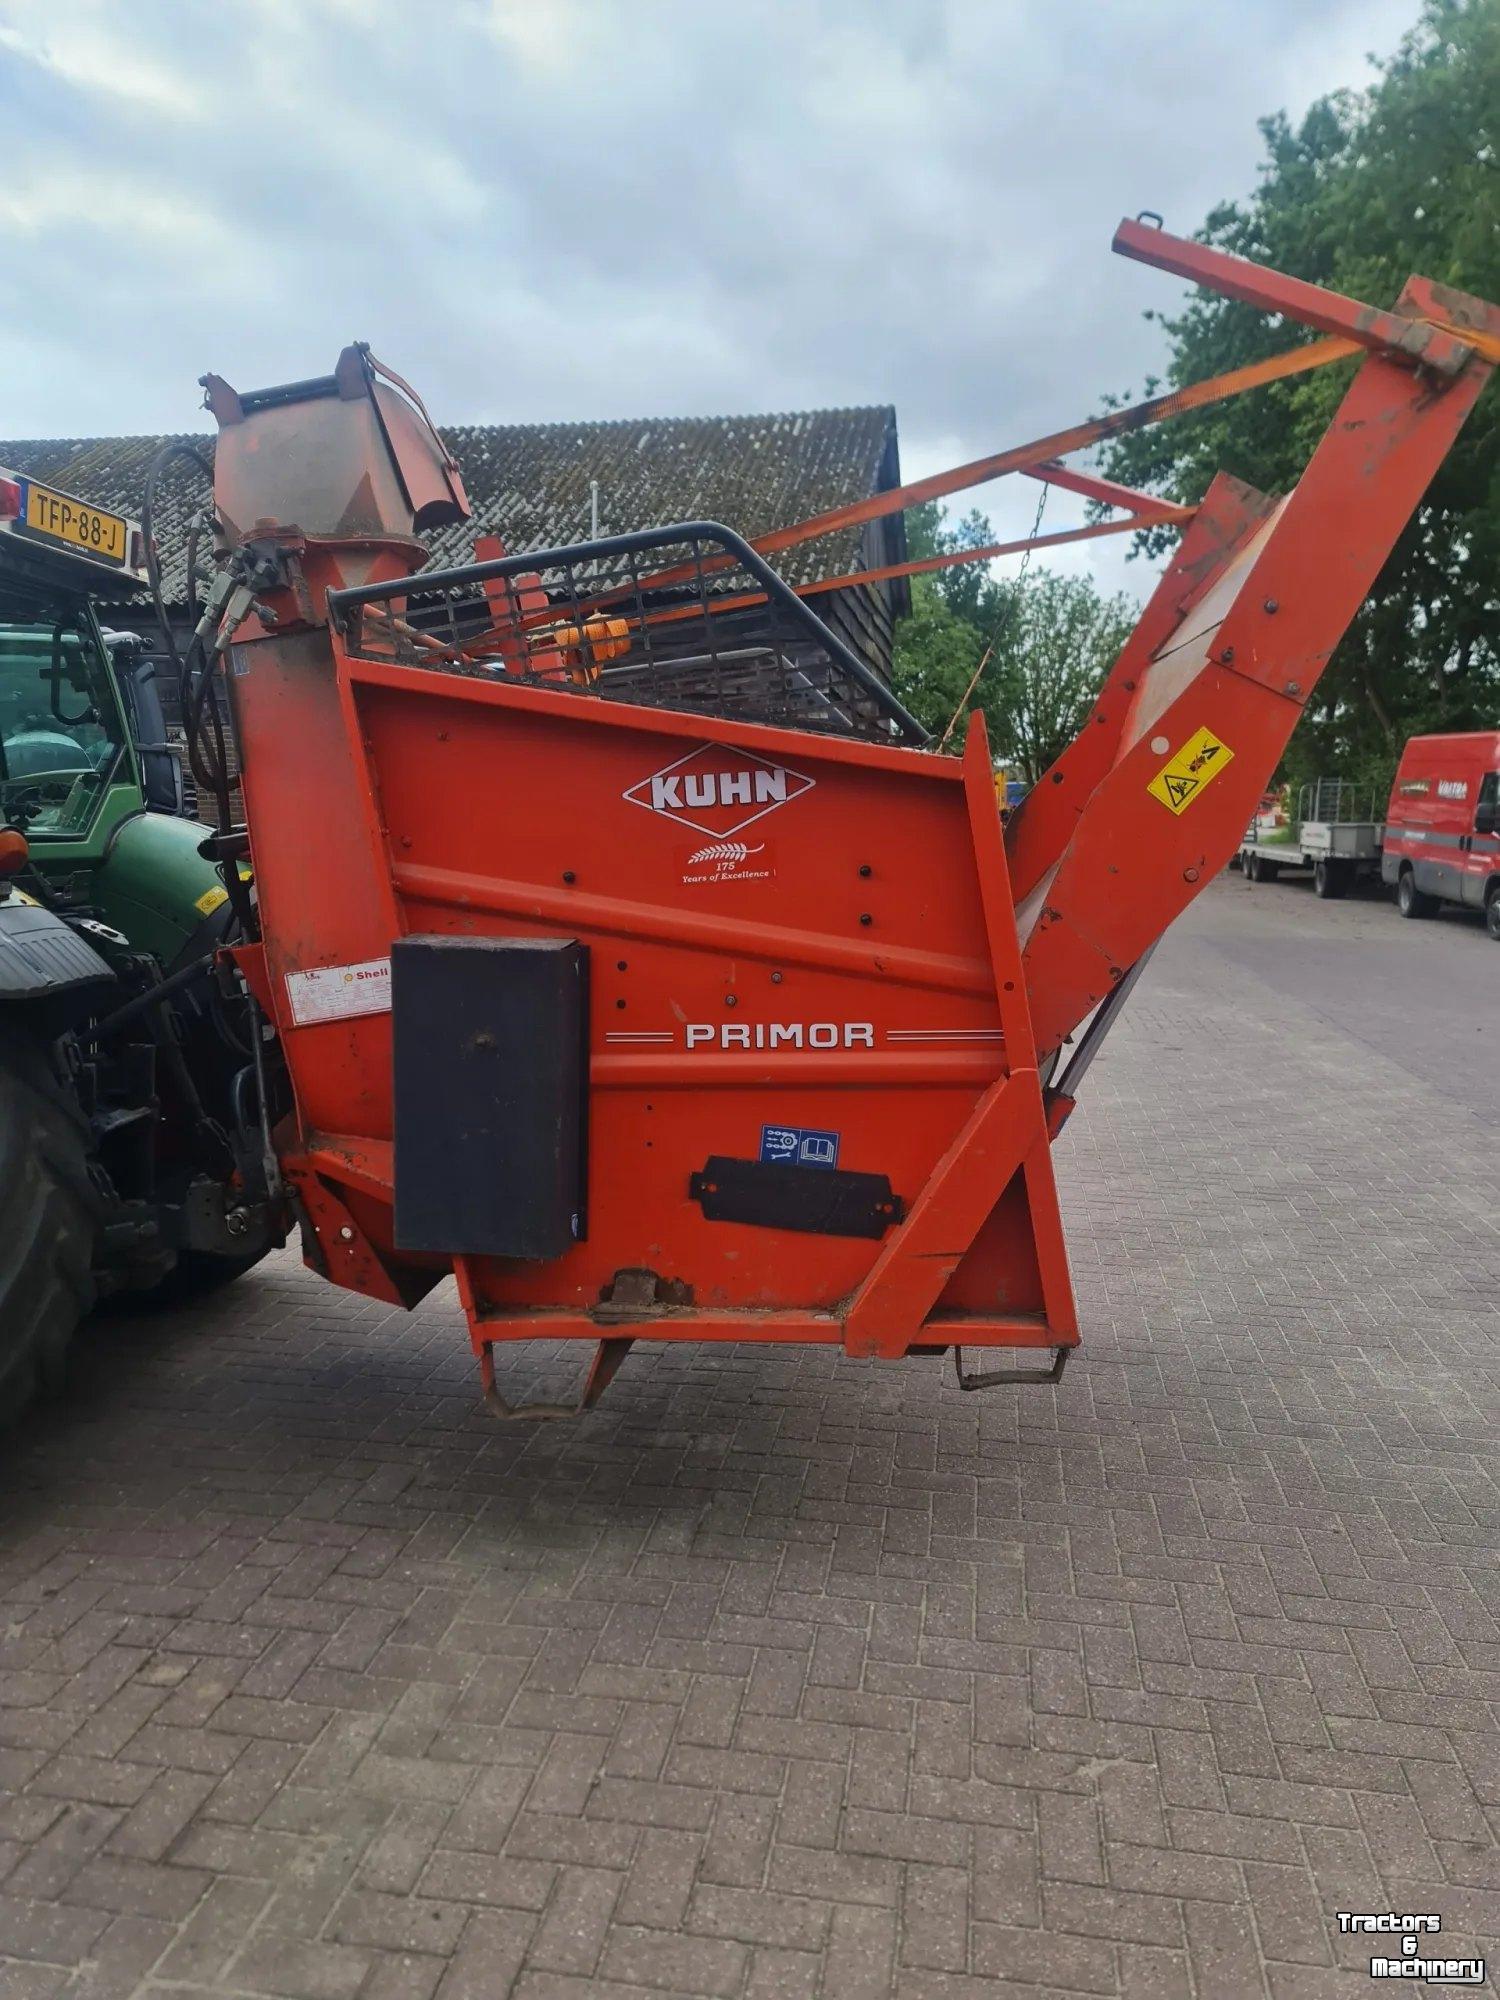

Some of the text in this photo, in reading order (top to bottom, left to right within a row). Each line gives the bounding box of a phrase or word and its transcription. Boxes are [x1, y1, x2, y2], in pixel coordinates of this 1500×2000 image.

[37, 493, 116, 551] TFP-88-J
[651, 768, 787, 809] KUHN
[716, 862, 735, 871] 175
[683, 870, 769, 883] Years of Excellence
[356, 968, 388, 980] Shell
[686, 1023, 874, 1048] PRIMOR
